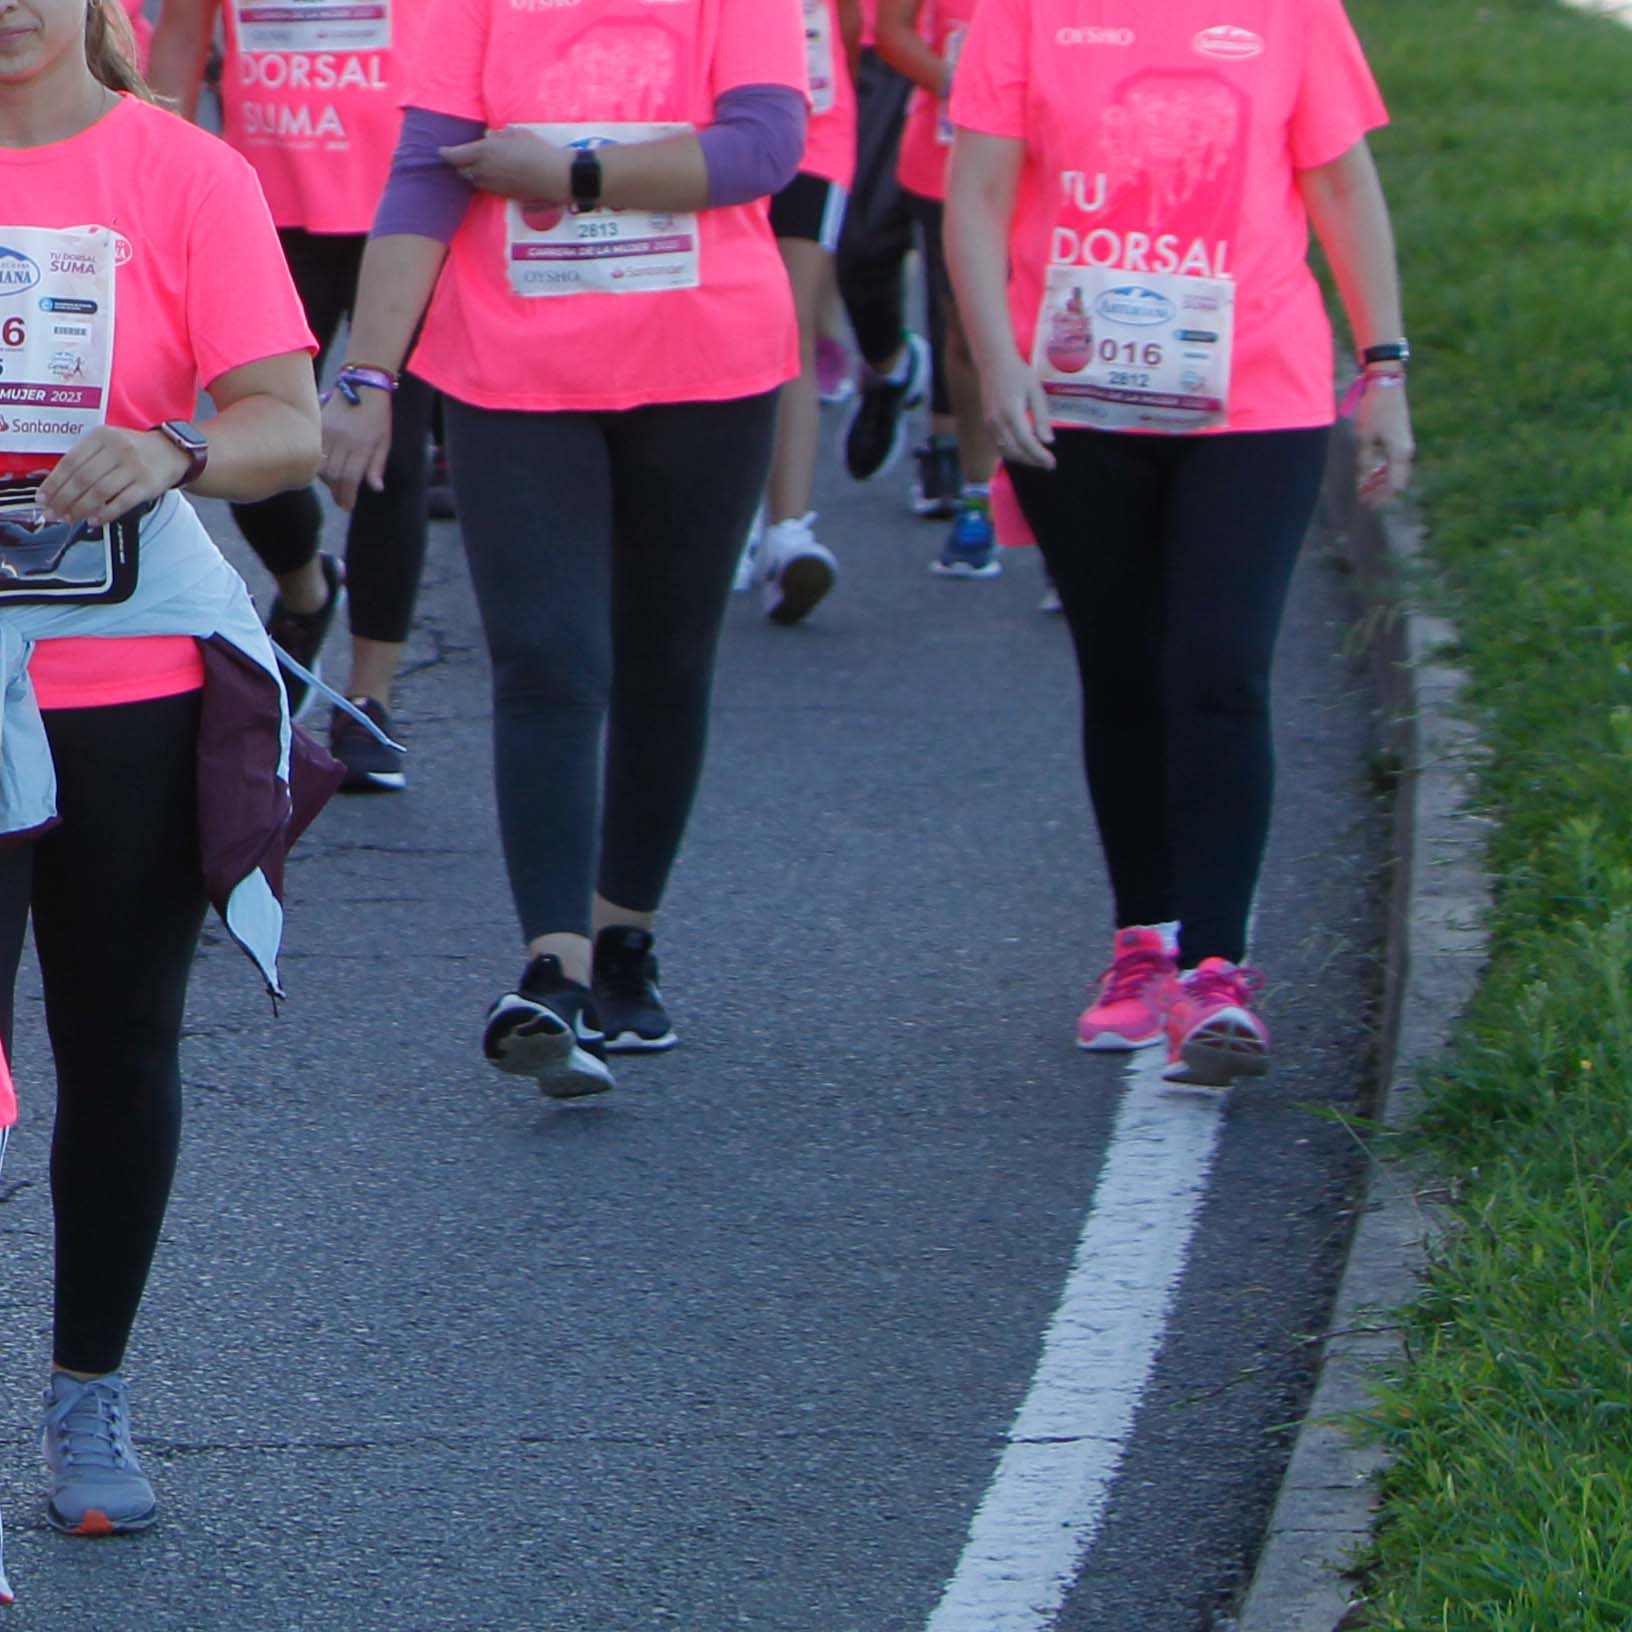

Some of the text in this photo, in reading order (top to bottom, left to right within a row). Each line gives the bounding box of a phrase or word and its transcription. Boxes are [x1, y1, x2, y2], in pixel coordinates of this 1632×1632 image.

[243, 102, 345, 137] SUMA
[1049, 228, 1232, 279] DORSAL
[50, 260, 96, 275] SUMA
[1098, 338, 1162, 365] 016
[0, 388, 46, 401] MUJER
[50, 390, 83, 403] 2023
[12, 418, 85, 435] Santander
